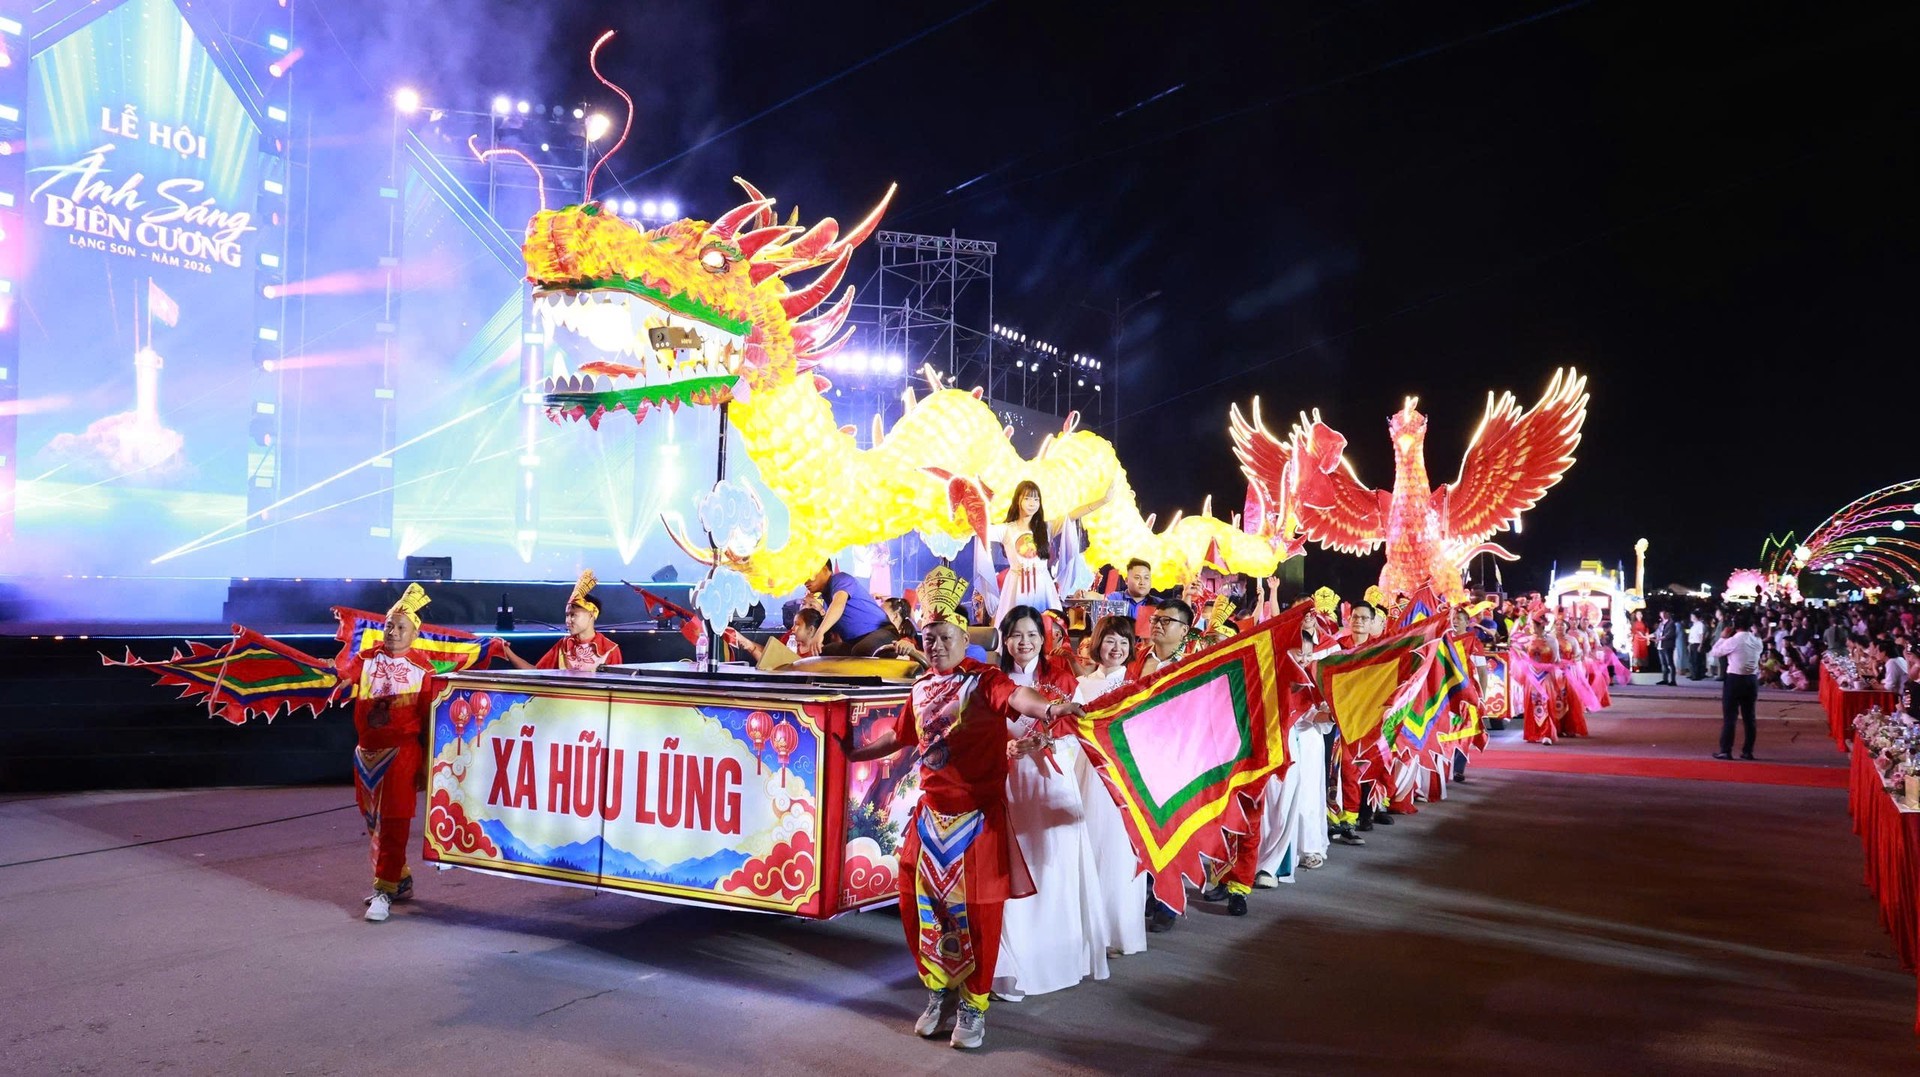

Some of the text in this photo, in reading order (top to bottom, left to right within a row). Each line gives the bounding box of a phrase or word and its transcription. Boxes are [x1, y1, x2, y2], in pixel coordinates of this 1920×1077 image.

[101, 104, 206, 160] LỄ HỘI
[26, 143, 257, 243] Ánh Sáng
[44, 193, 241, 268] BIÊN CƯƠNG
[69, 234, 106, 251] LẠNG
[110, 243, 136, 257] SƠN
[152, 251, 180, 267] NĂM
[184, 259, 212, 274] 2026
[487, 725, 743, 835] XÃ HỮU LŨNG
